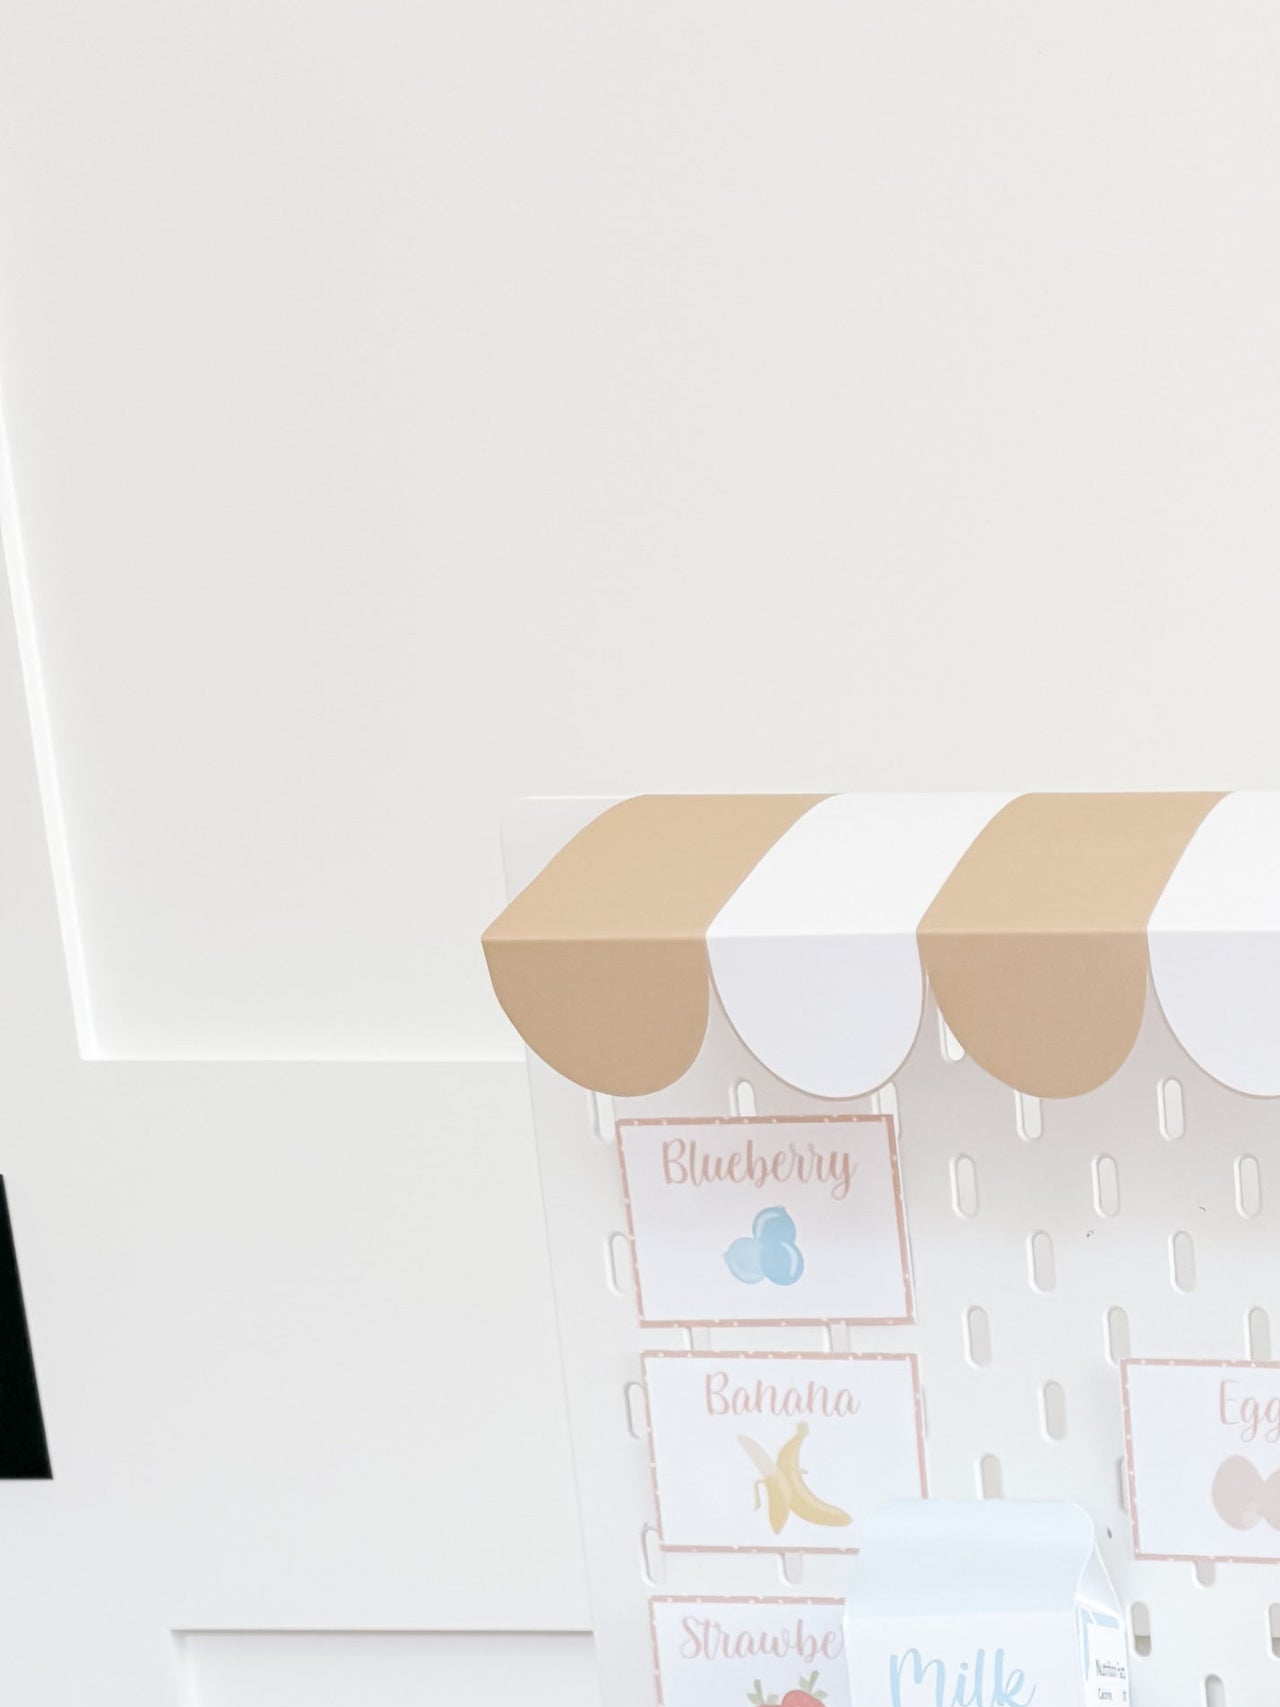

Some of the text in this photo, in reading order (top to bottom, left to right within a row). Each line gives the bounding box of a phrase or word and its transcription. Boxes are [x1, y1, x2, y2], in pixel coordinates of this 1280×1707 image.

[662, 1138, 857, 1200] Blueberry
[705, 1371, 860, 1418] Banana
[680, 1616, 844, 1663] Strawbe
